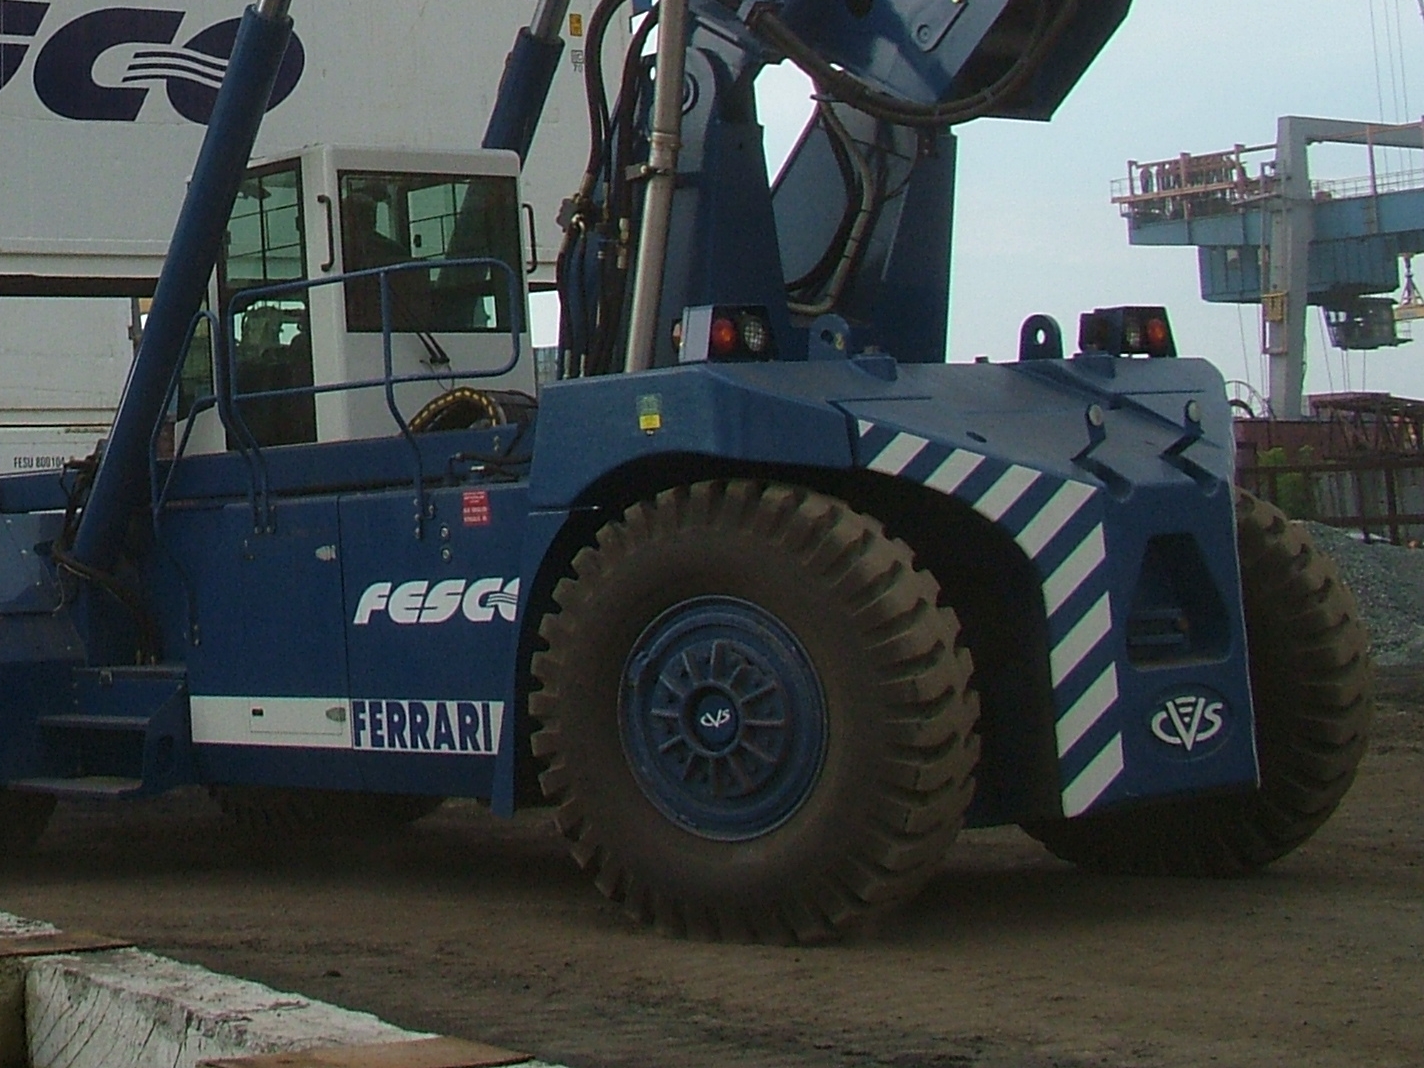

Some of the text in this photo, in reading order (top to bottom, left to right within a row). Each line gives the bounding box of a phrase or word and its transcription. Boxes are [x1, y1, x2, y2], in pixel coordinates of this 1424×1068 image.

[14, 456, 34, 468] FESU
[353, 700, 493, 752] FERRARI
[700, 708, 731, 728] CVS
